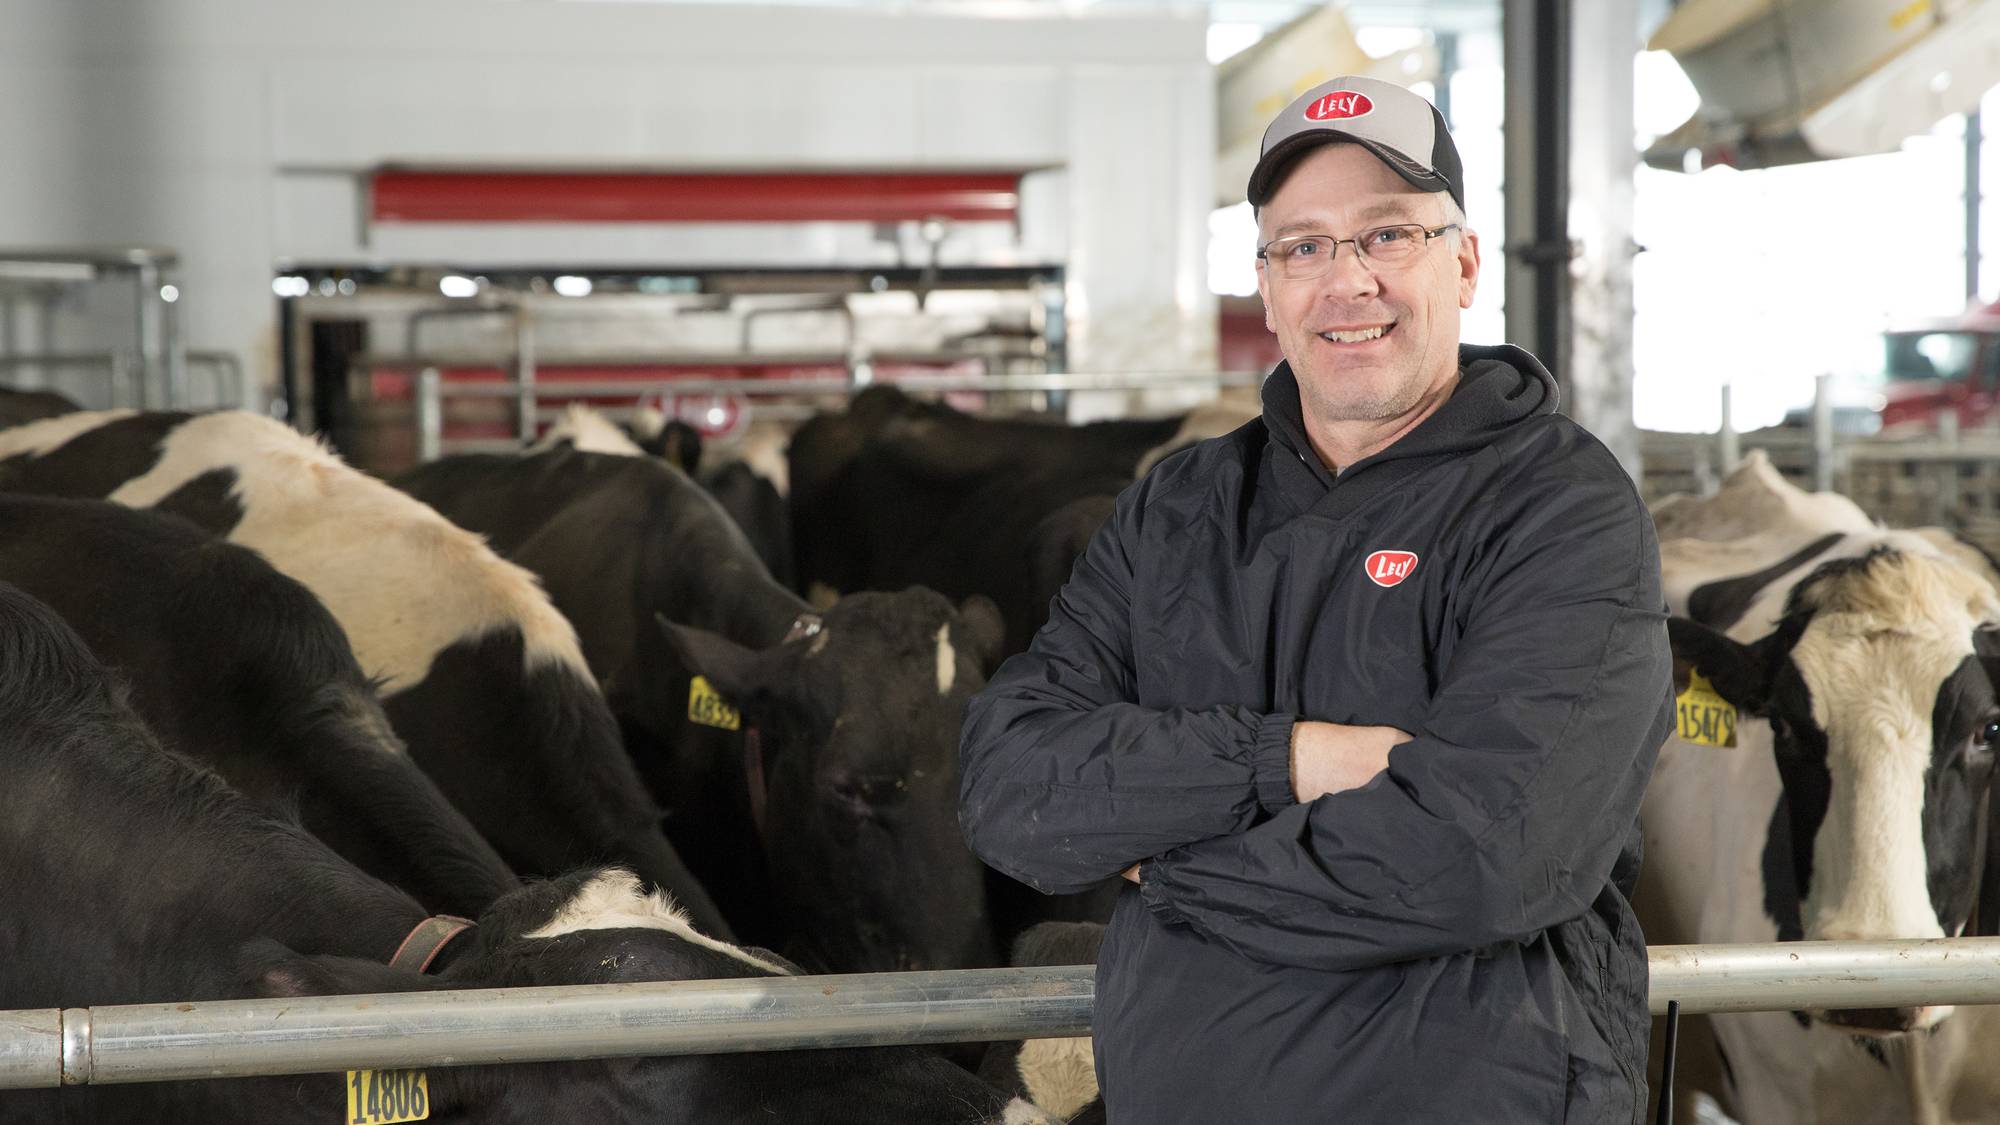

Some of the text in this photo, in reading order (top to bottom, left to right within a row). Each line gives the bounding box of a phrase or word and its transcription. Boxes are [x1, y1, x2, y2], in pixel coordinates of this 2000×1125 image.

[1317, 94, 1360, 118] LELY
[1375, 555, 1414, 578] LELY
[1680, 703, 1735, 743] 15479
[352, 1070, 425, 1124] 14806
